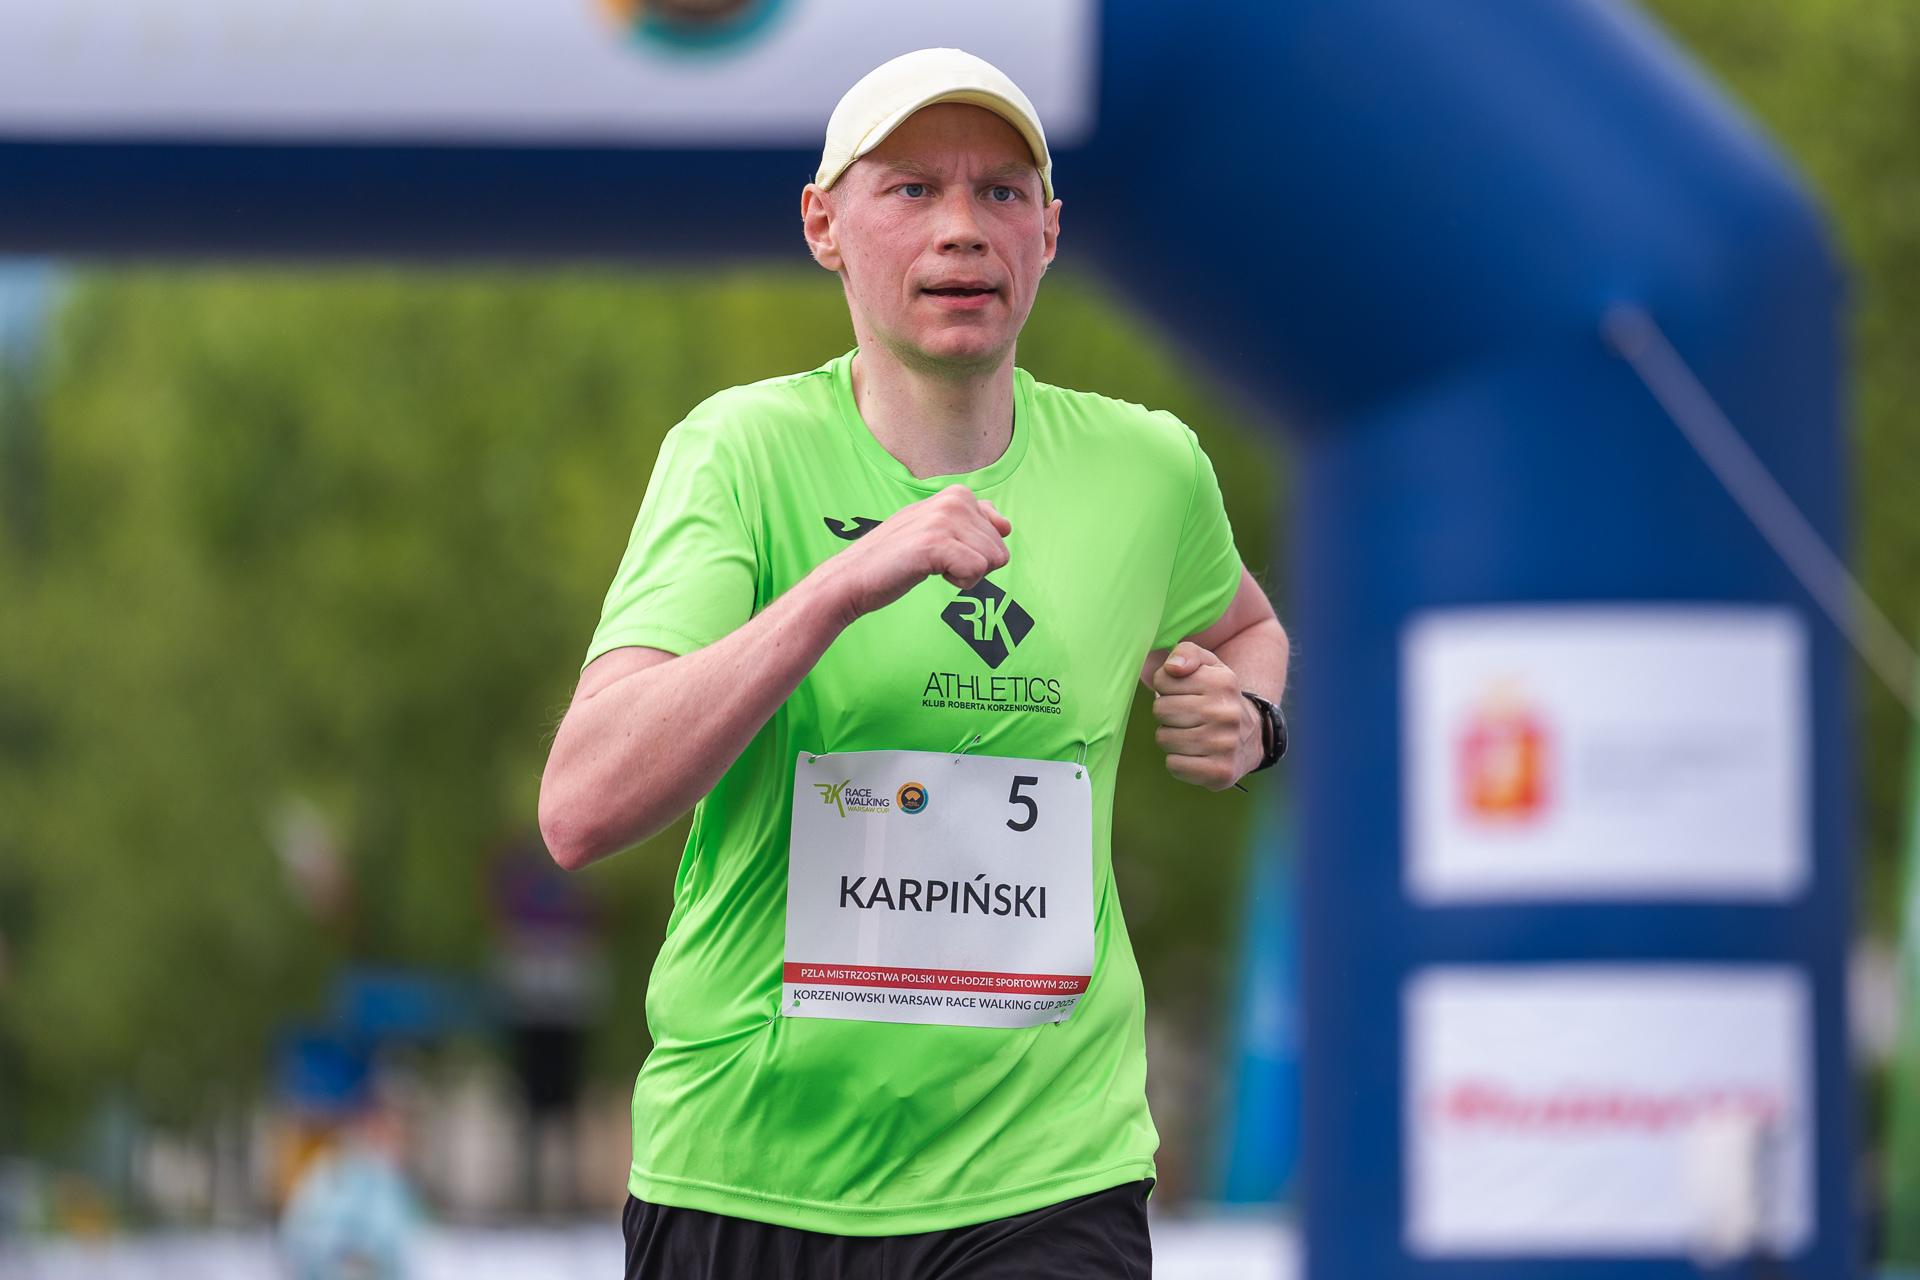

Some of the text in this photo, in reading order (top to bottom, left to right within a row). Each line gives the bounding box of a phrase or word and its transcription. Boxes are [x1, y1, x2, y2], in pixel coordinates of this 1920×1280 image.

[923, 672, 1061, 705] ATHLETICS
[922, 699, 1061, 715] KLUB ROBERTA KORZENIOWSKIEGO
[845, 788, 872, 798] RACE
[845, 797, 890, 807] WALKING
[1006, 775, 1038, 832] 5
[839, 873, 1046, 919] KARPIŃSKI
[801, 968, 1079, 990] PZLA MISTRZOSTWA POLSKI W CHODZIE SPORTOWYM 2025
[793, 989, 1076, 1010] KORZENIOWSKI WARSAW RACE WALKING CUP 2025
